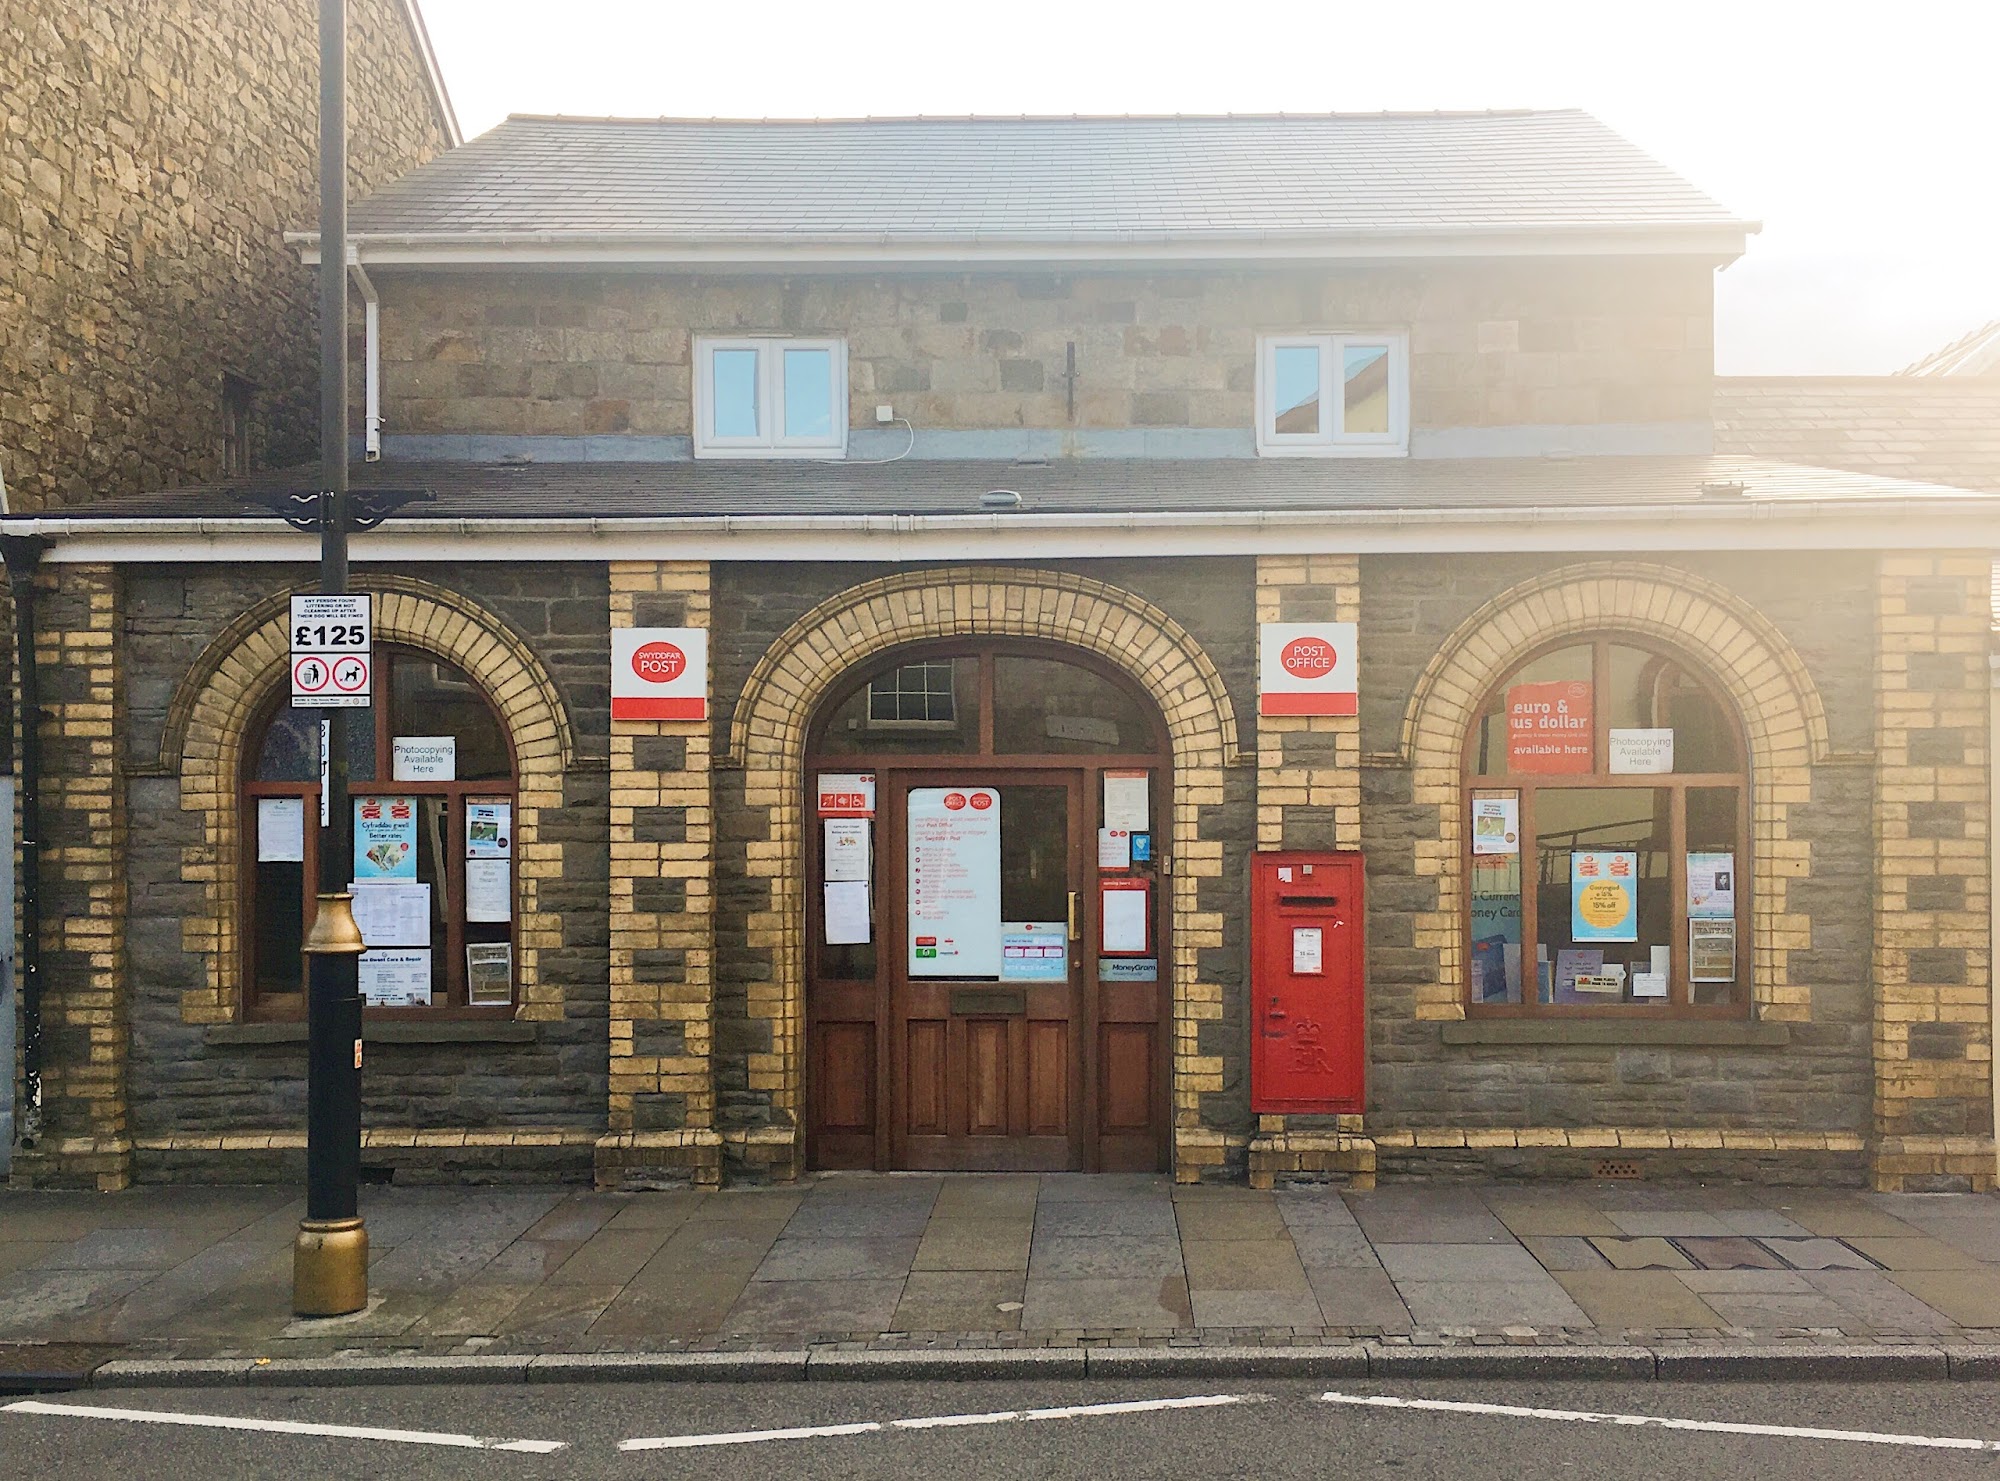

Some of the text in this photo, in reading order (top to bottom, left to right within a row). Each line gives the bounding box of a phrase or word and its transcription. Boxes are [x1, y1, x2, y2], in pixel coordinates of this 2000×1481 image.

[295, 625, 365, 646] £125
[1294, 646, 1325, 656] POST
[641, 661, 678, 673] POST
[1286, 658, 1330, 668] OFFICE
[1514, 699, 1568, 714] euro &
[1514, 714, 1587, 728] us dollar
[1610, 738, 1670, 747] Photocopying
[394, 746, 453, 755] Photocopying
[1514, 745, 1588, 754] available here
[1471, 910, 1497, 921] oney
